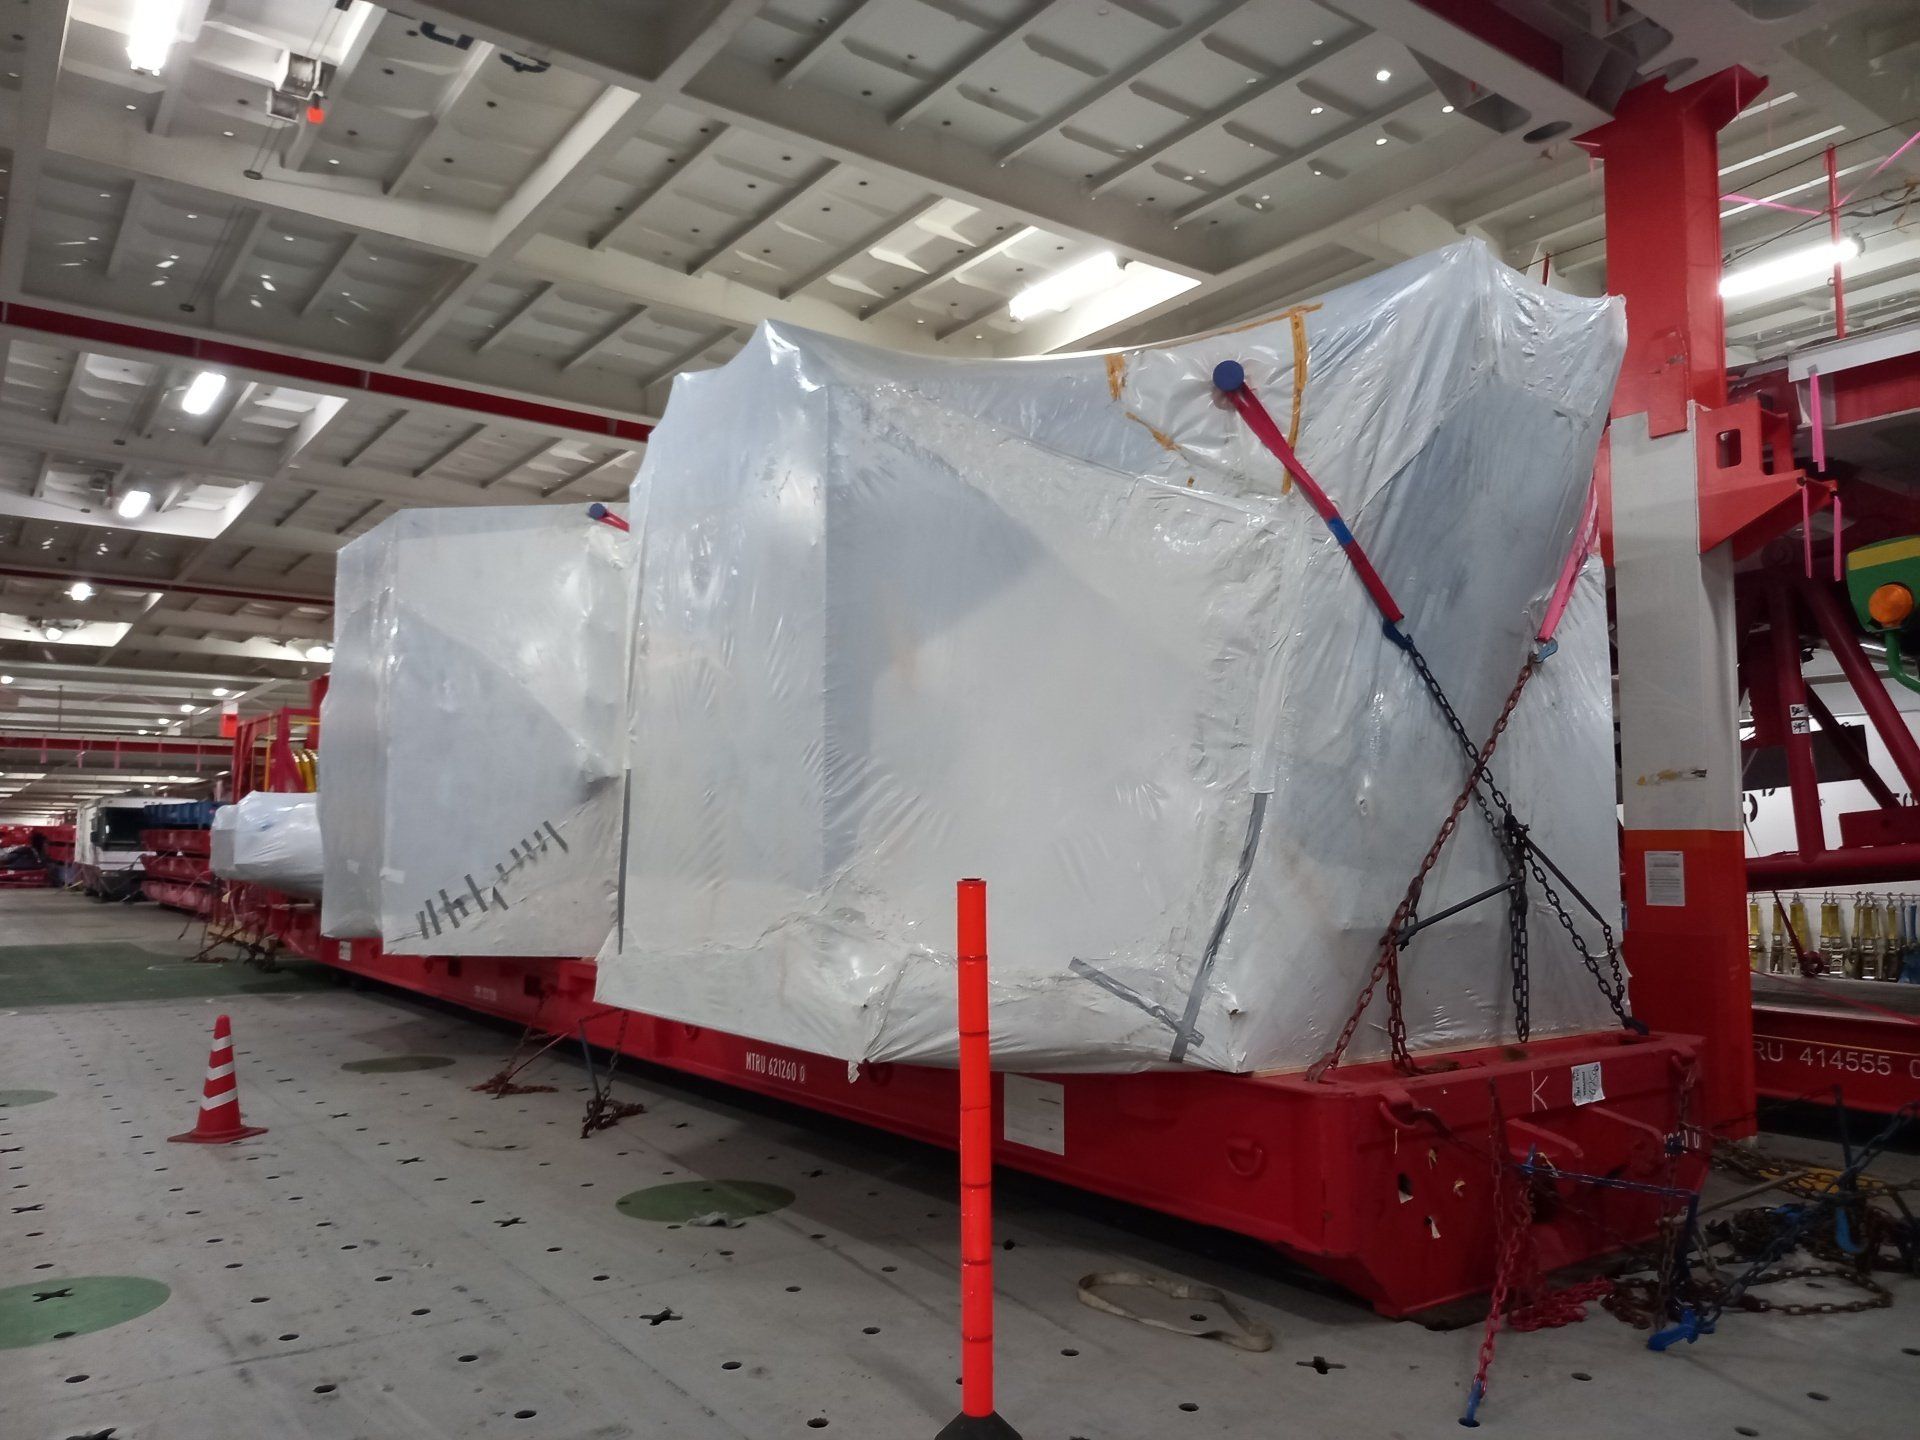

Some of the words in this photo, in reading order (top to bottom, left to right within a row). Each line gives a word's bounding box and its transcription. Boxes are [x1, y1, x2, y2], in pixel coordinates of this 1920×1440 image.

[745, 1051, 766, 1074] MTRU
[768, 1057, 797, 1082] 621260
[1799, 1046, 1892, 1076] 414555
[1531, 1071, 1549, 1113] K
